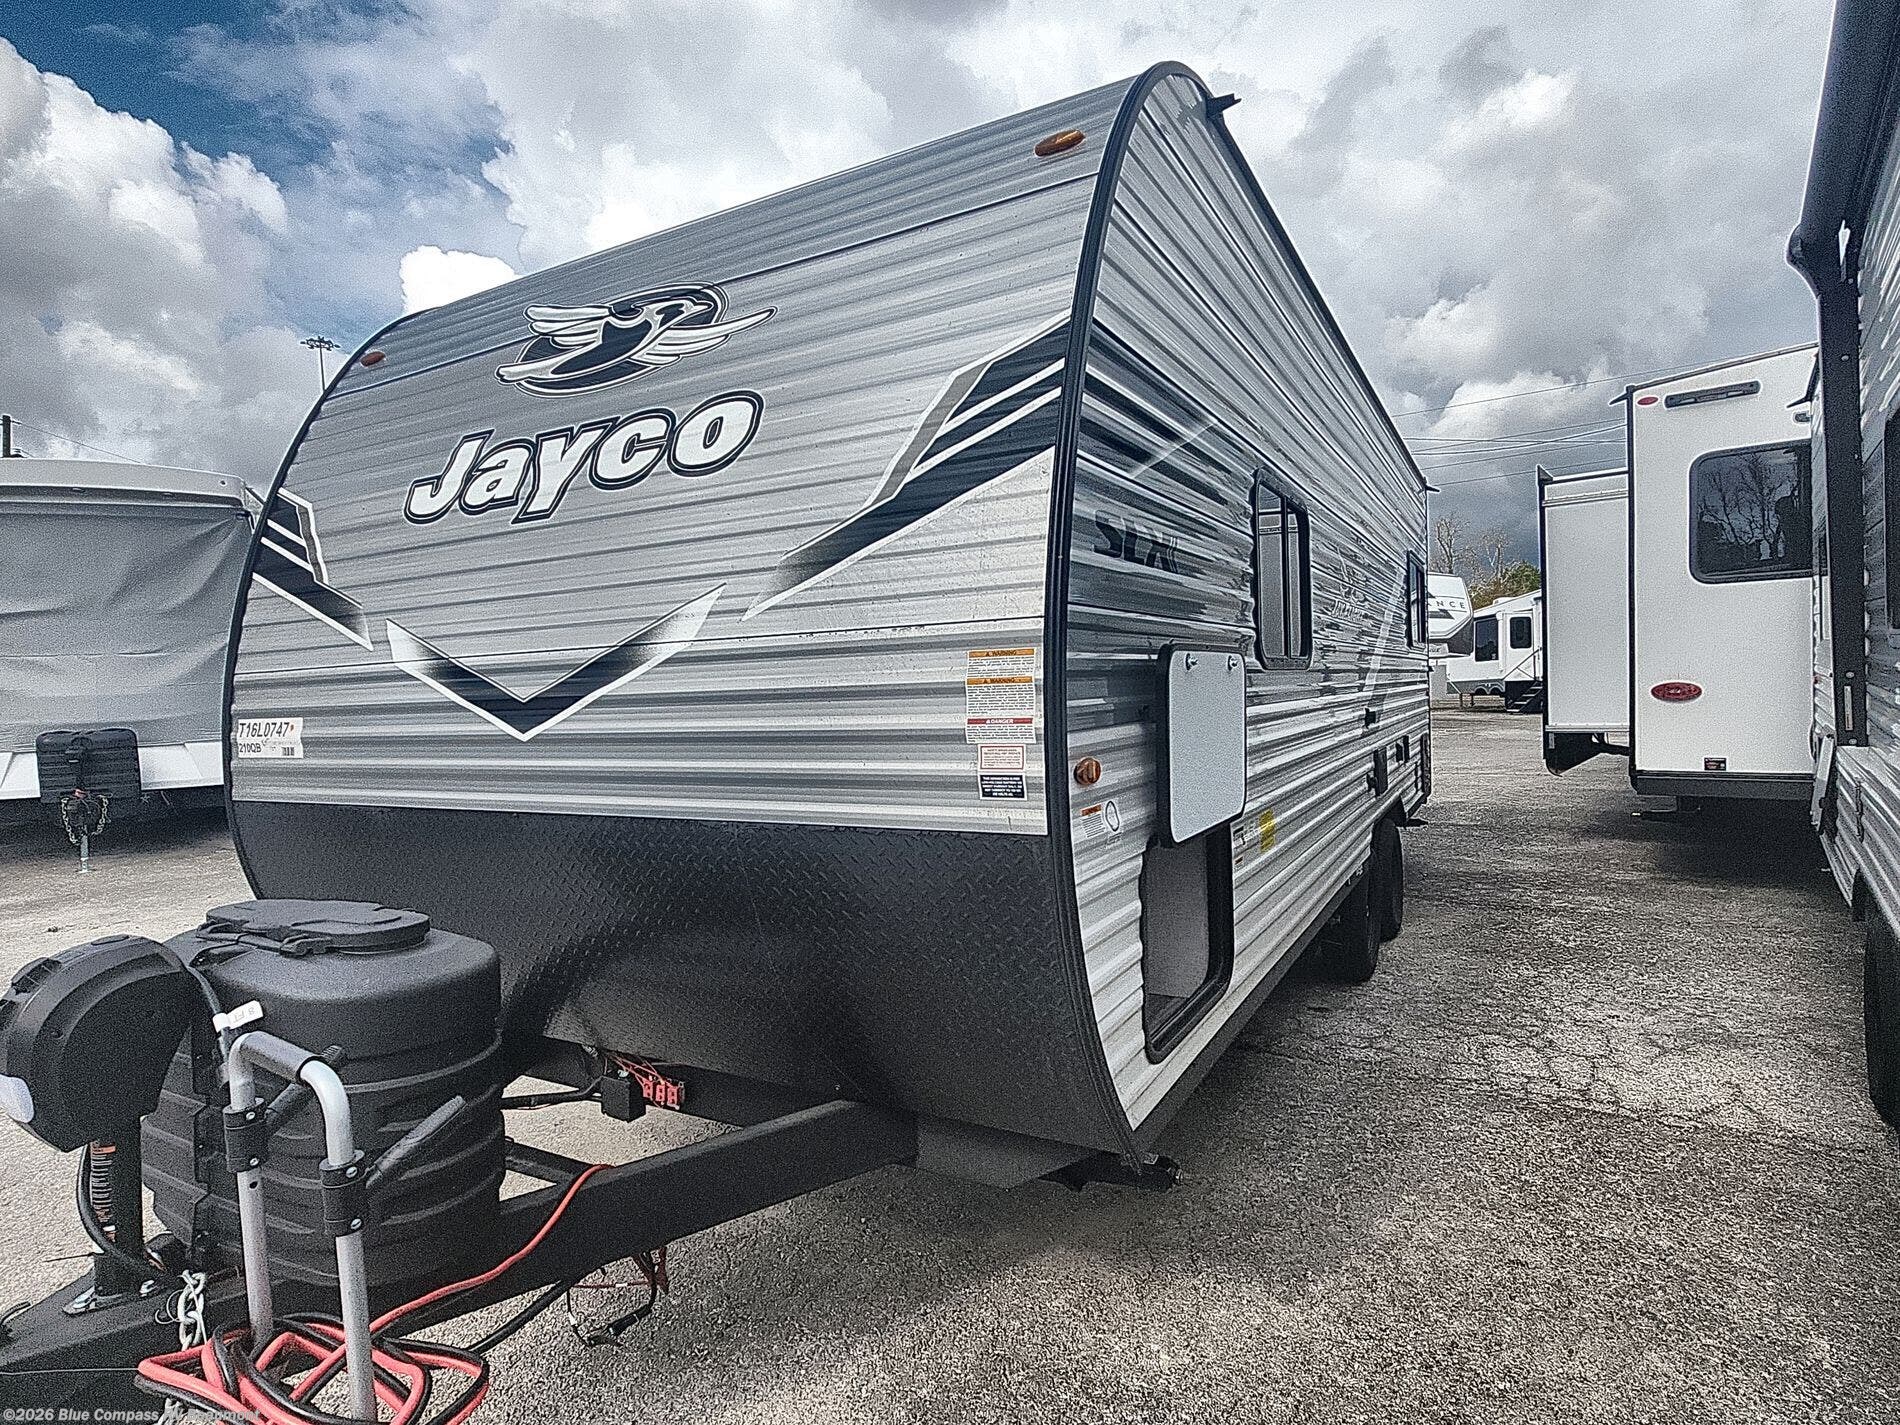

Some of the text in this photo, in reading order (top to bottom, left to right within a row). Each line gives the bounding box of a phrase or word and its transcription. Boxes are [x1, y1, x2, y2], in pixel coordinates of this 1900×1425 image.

[404, 390, 765, 525] Jayco
[239, 721, 290, 738] T16L0747
[239, 742, 262, 753] 210QB
